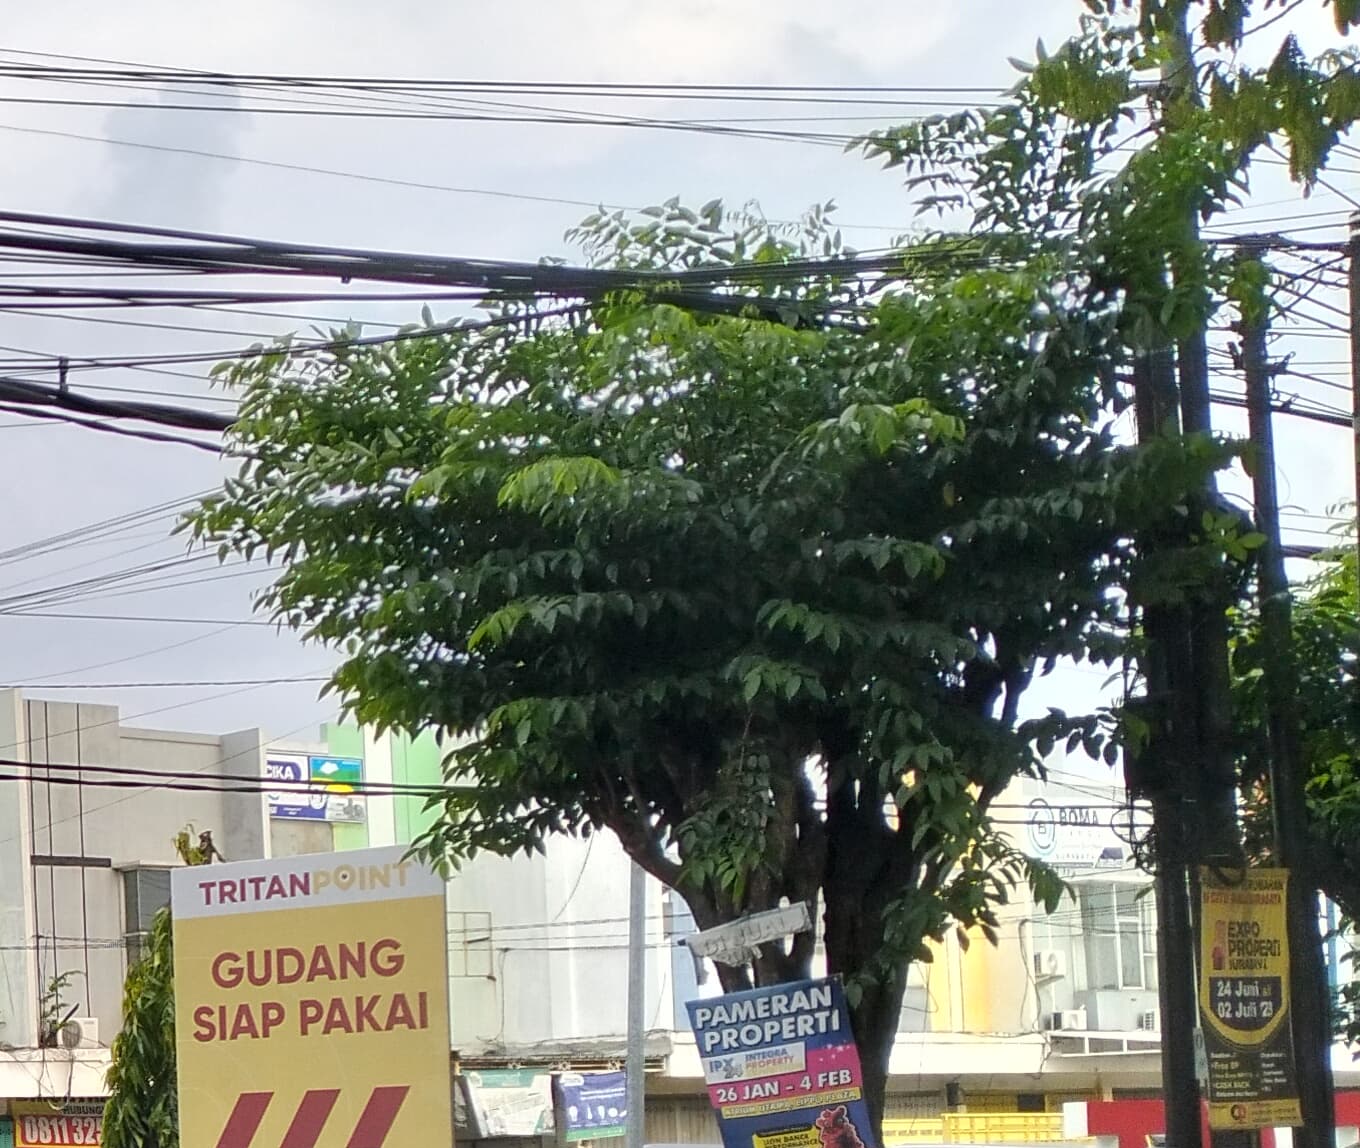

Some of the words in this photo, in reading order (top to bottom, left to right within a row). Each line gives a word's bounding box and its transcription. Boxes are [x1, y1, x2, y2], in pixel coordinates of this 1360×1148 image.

[211, 938, 405, 989] GUDANG
[695, 985, 832, 1030] PAMERAN
[1217, 980, 1232, 997] 24
[1235, 980, 1260, 997] Juni
[192, 1002, 286, 1042] SIAP
[300, 991, 429, 1036] PAKAI
[1217, 1001, 1233, 1018] 02
[1235, 1002, 1257, 1018] Juli
[704, 1009, 840, 1053] PROPERTI
[717, 1087, 738, 1103] 26
[743, 1081, 779, 1101] JAN
[800, 1075, 812, 1091] 4
[818, 1069, 852, 1089] FEB
[24, 1116, 70, 1144] 0811
